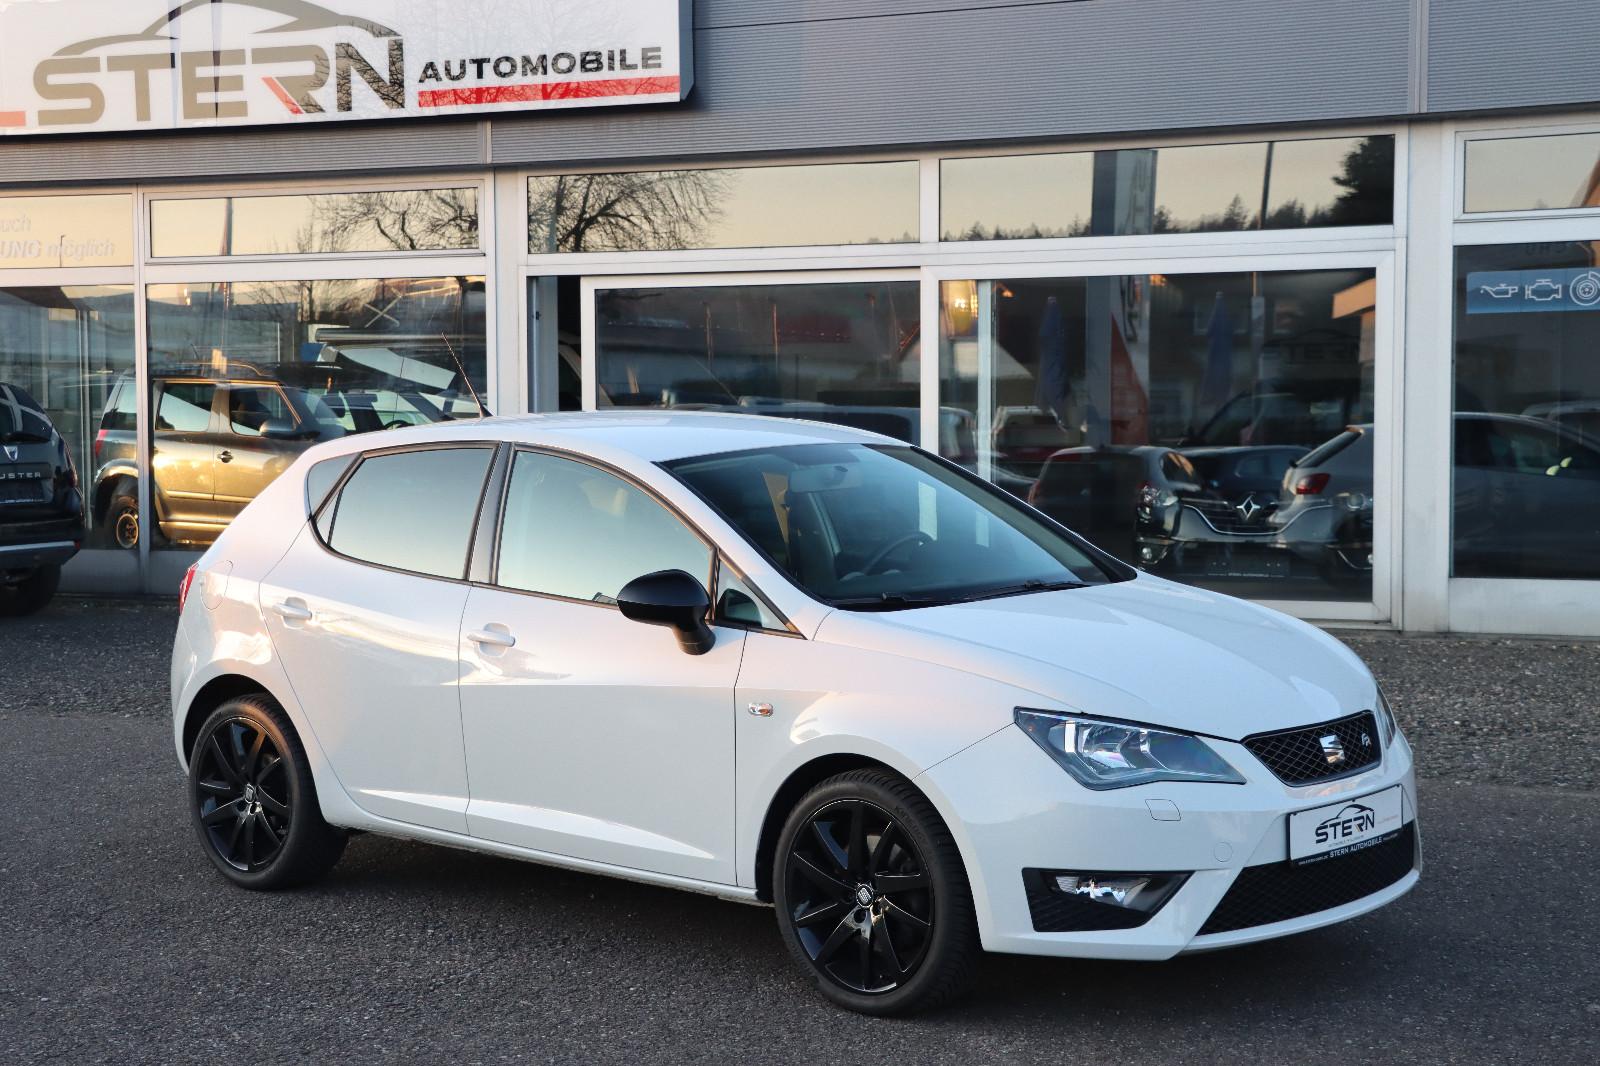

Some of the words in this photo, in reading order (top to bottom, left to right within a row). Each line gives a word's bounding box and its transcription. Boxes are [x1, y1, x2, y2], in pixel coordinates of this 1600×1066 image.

[418, 46, 662, 83] AUTOMOBILE
[34, 38, 405, 126] STERN
[47, 237, 116, 261] möglich
[1315, 811, 1375, 844] STERN
[1329, 847, 1349, 858] STERN
[1350, 837, 1383, 850] AUTOMOBILE
